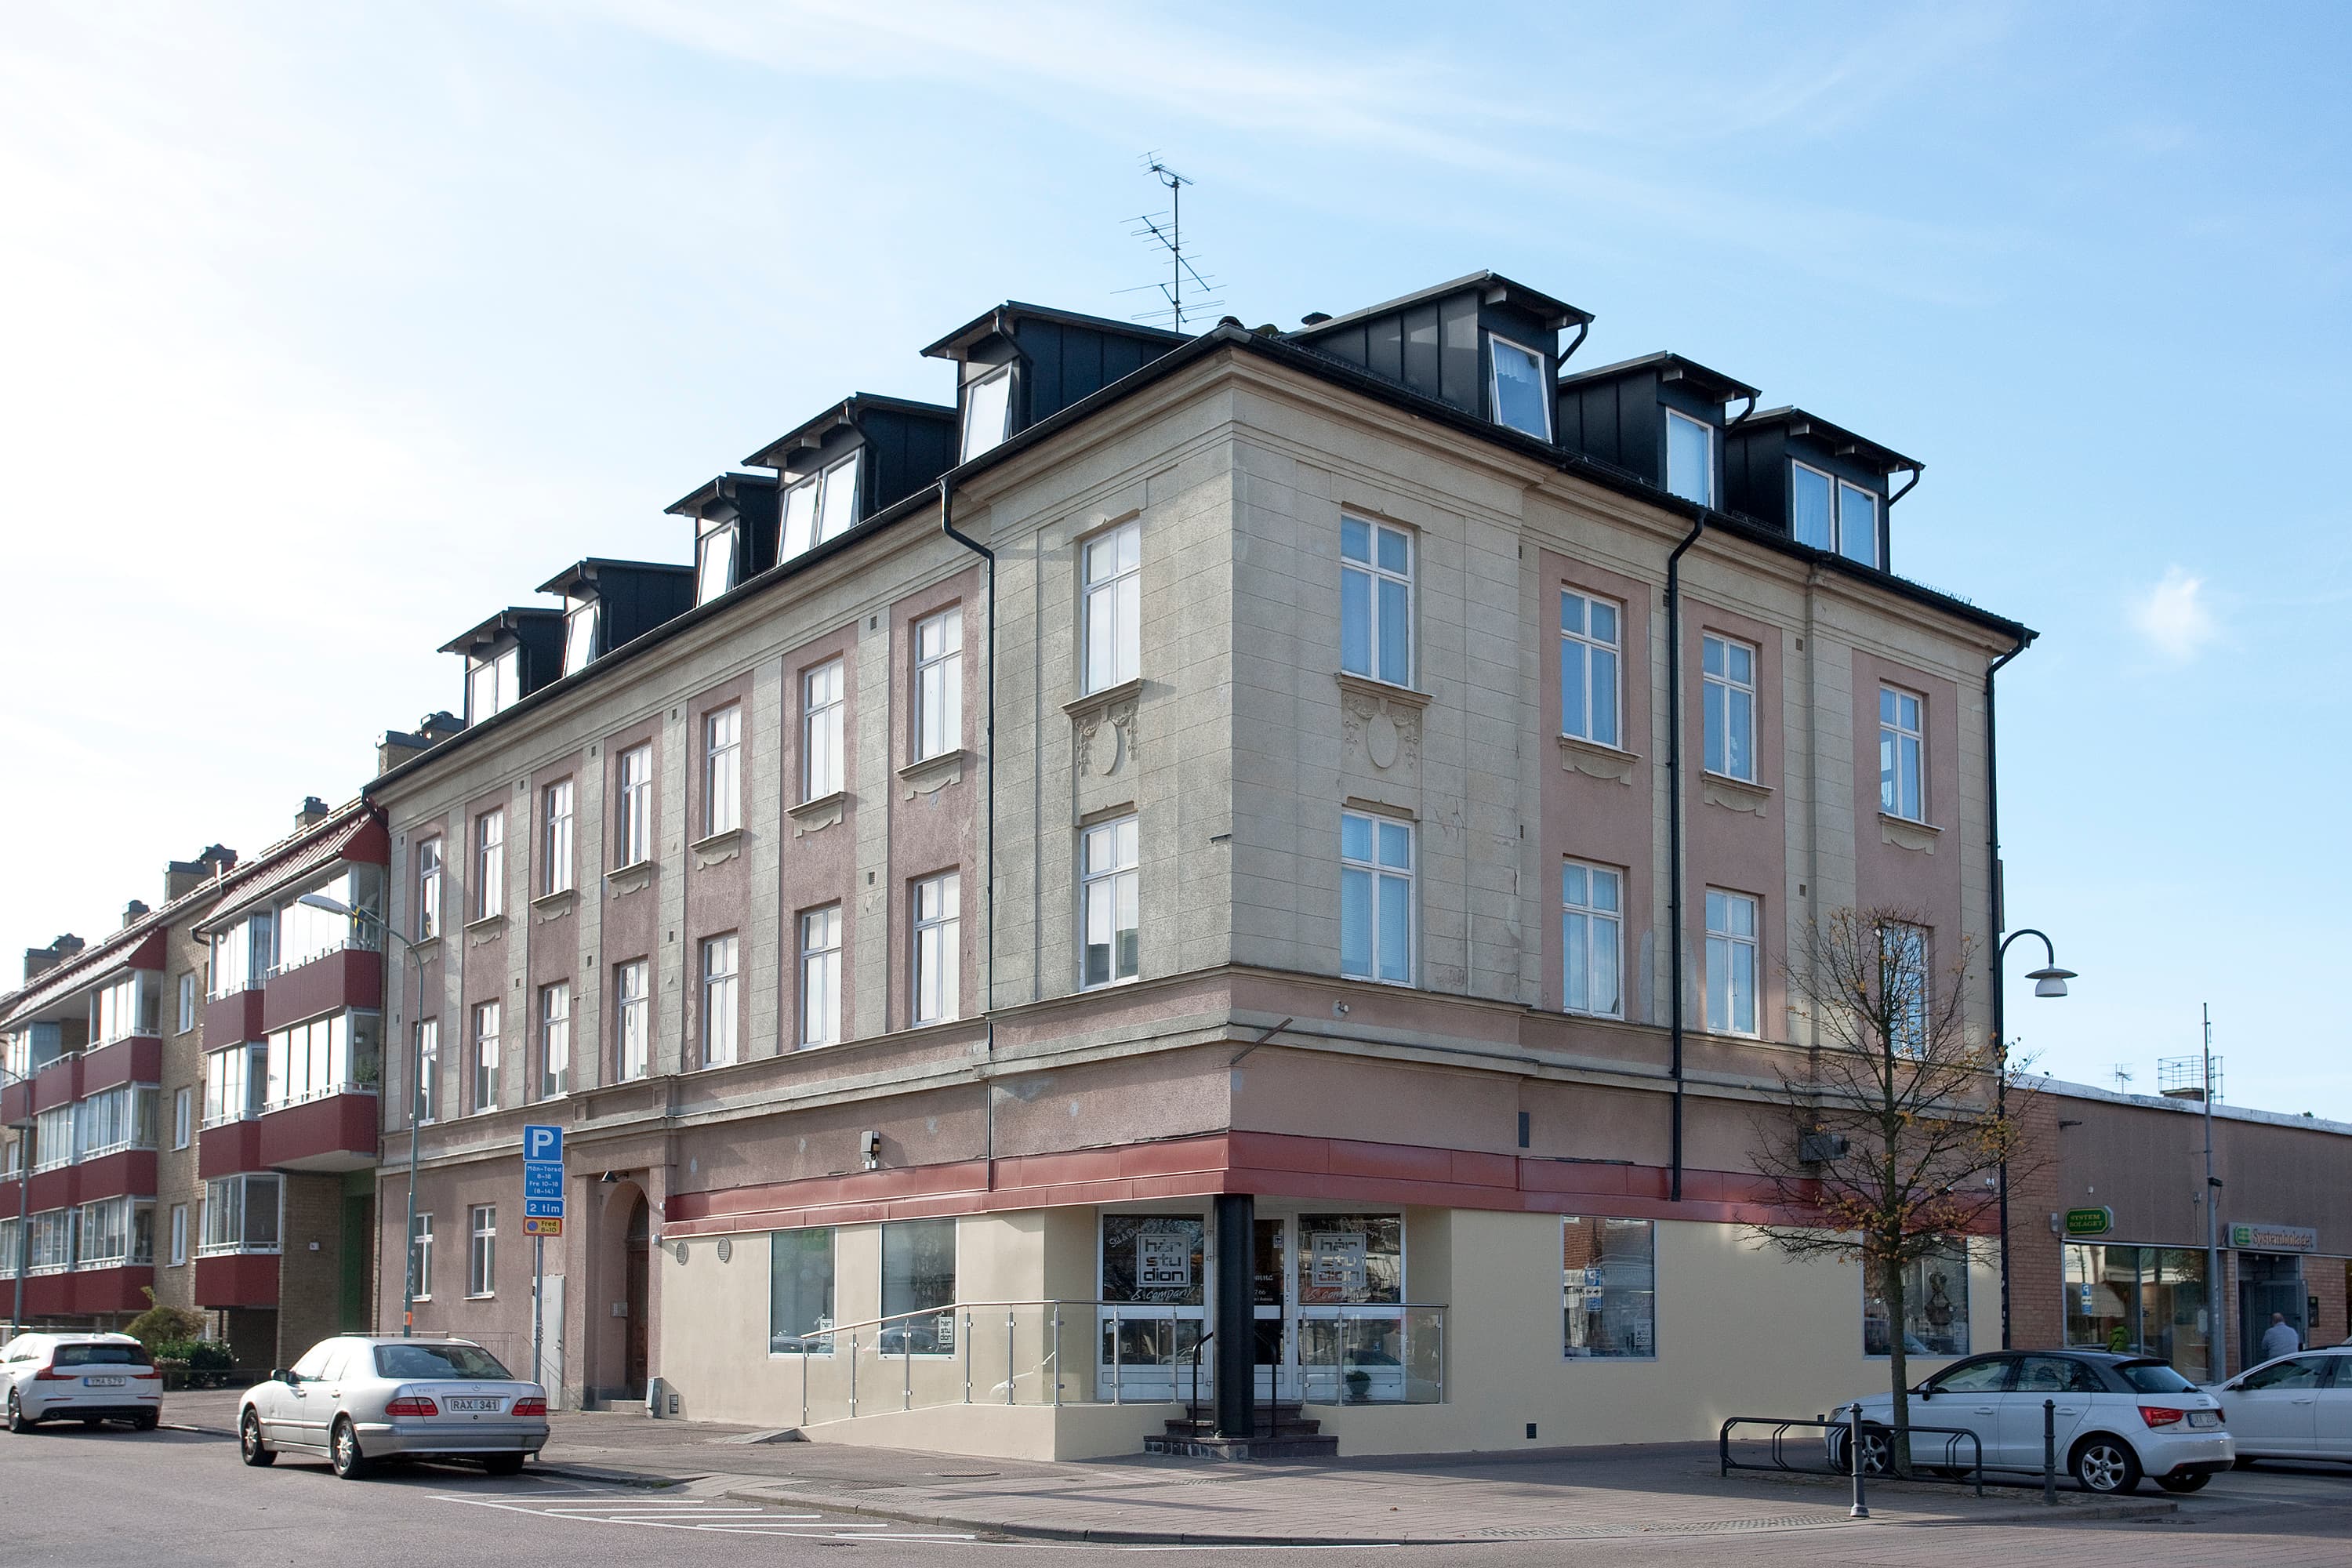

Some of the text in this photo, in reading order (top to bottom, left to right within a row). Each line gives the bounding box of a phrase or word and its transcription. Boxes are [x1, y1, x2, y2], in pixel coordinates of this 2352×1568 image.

[532, 1129, 554, 1157] P
[530, 1203, 560, 1213] 2 tim
[2252, 1229, 2314, 1250] Systembolaget
[1145, 1254, 1181, 1267] stu
[1143, 1268, 1184, 1282] dion
[1145, 1287, 1195, 1301] company
[453, 1400, 497, 1410] RAX 341
